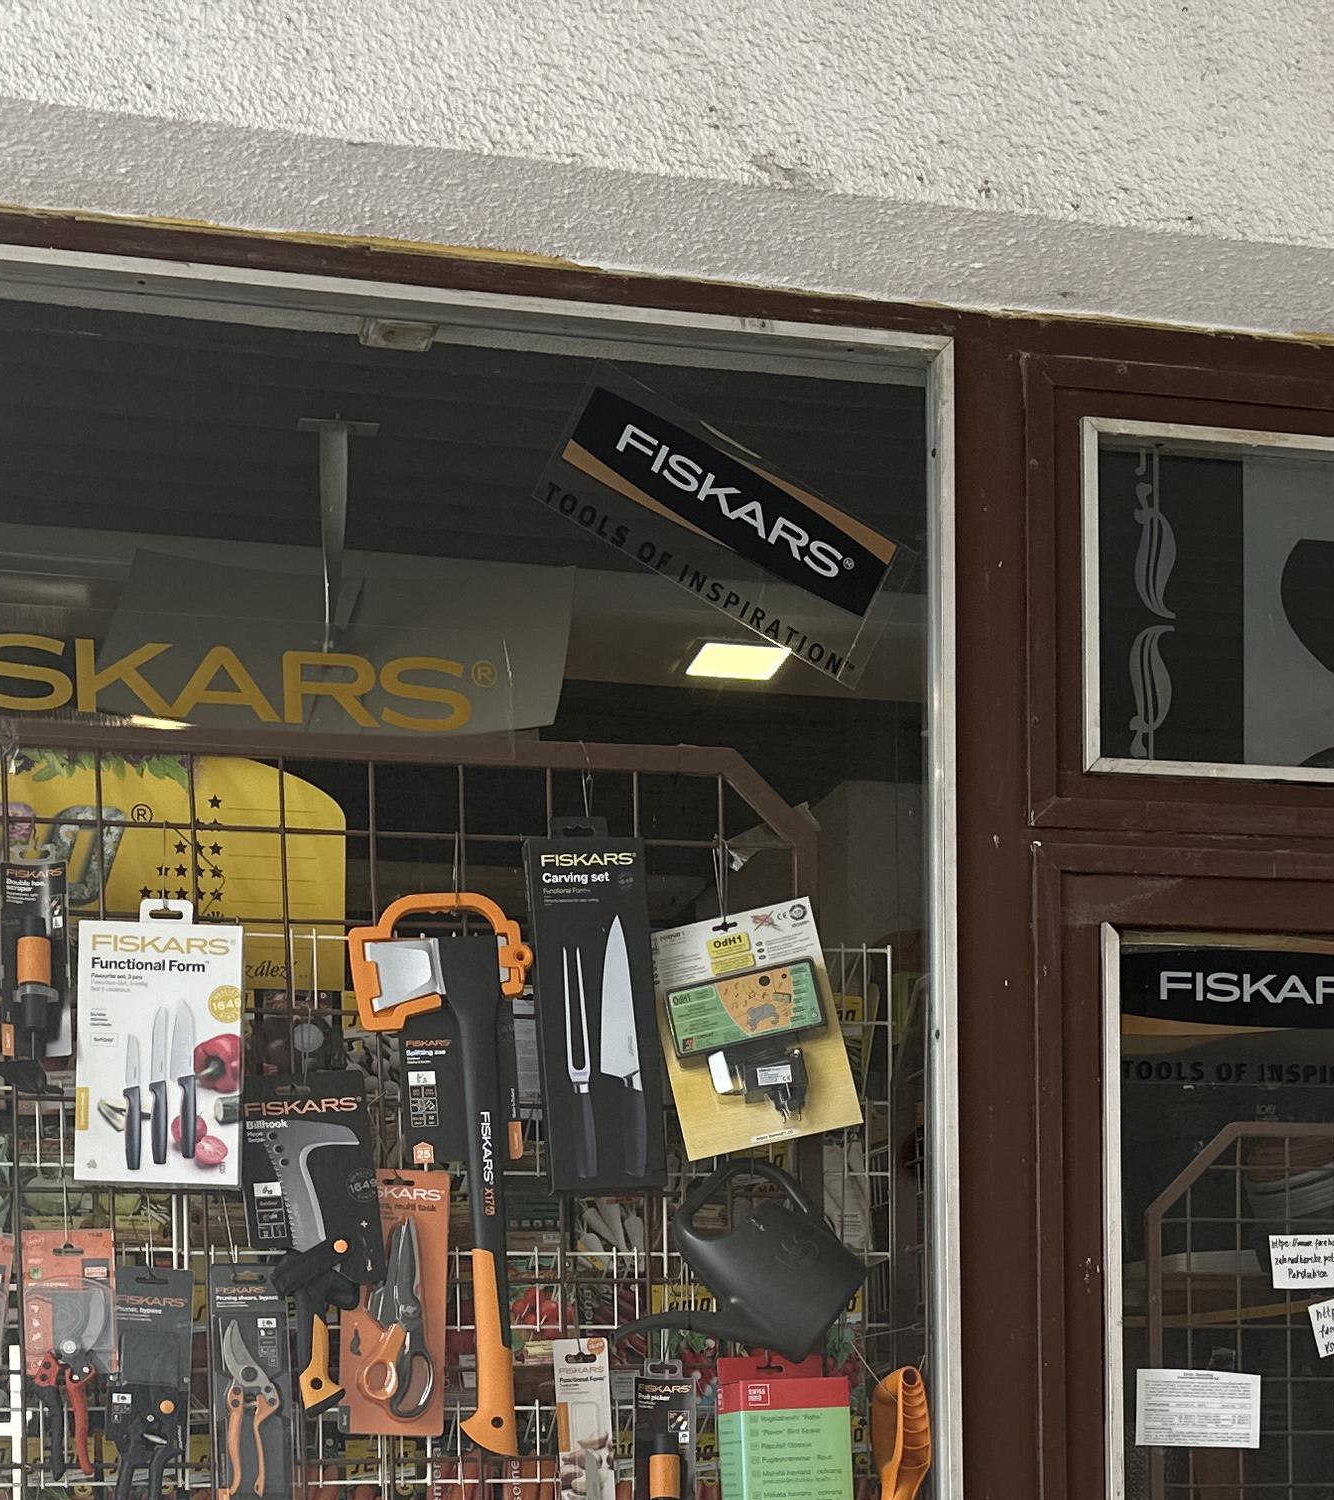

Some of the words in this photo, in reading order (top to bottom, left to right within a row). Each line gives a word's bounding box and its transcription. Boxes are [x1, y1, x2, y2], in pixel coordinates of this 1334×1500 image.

[546, 483, 627, 549] TOOLS
[639, 541, 673, 576] OF
[678, 564, 843, 675] INSPIRATION
[540, 853, 633, 867] FISKARS
[6, 868, 63, 878] FISKARS
[542, 872, 589, 885] Carving
[591, 871, 610, 883] set
[91, 934, 230, 955] FISKARS
[713, 934, 742, 949] OdH1
[91, 957, 165, 971] Functional
[168, 960, 205, 973] Form
[1123, 1060, 1205, 1082] TOOLS
[1216, 1061, 1247, 1082] OF
[244, 1097, 359, 1117] FISKARS
[246, 1119, 289, 1130] Billhook
[480, 1111, 494, 1183] FISKARS
[484, 1187, 495, 1206] X17
[395, 1203, 413, 1211] multi
[417, 1204, 436, 1213] task
[638, 1384, 690, 1394] FISKARS
